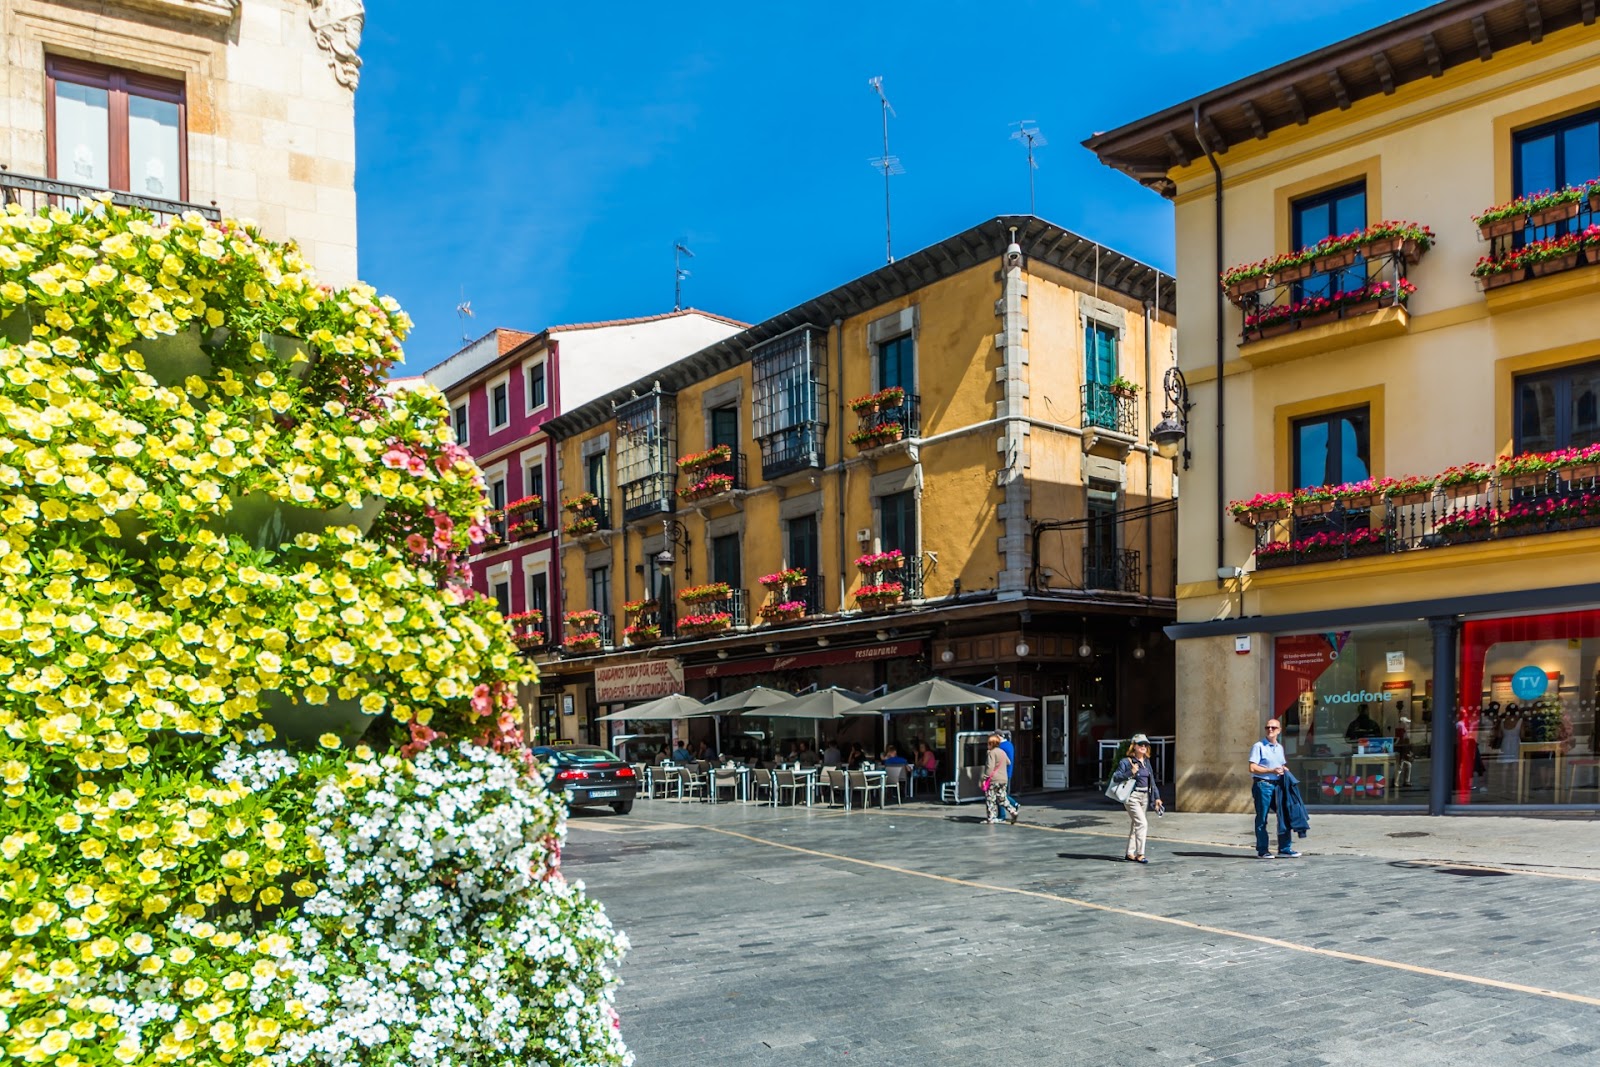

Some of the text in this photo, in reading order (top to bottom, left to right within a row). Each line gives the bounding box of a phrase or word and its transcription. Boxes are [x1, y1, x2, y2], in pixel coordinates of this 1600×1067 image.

[855, 646, 898, 658] restaurante
[625, 665, 638, 679] TODO
[639, 663, 650, 677] POR
[650, 661, 668, 675] CIERRE
[1519, 676, 1541, 689] TV
[1323, 690, 1392, 704] vodafone
